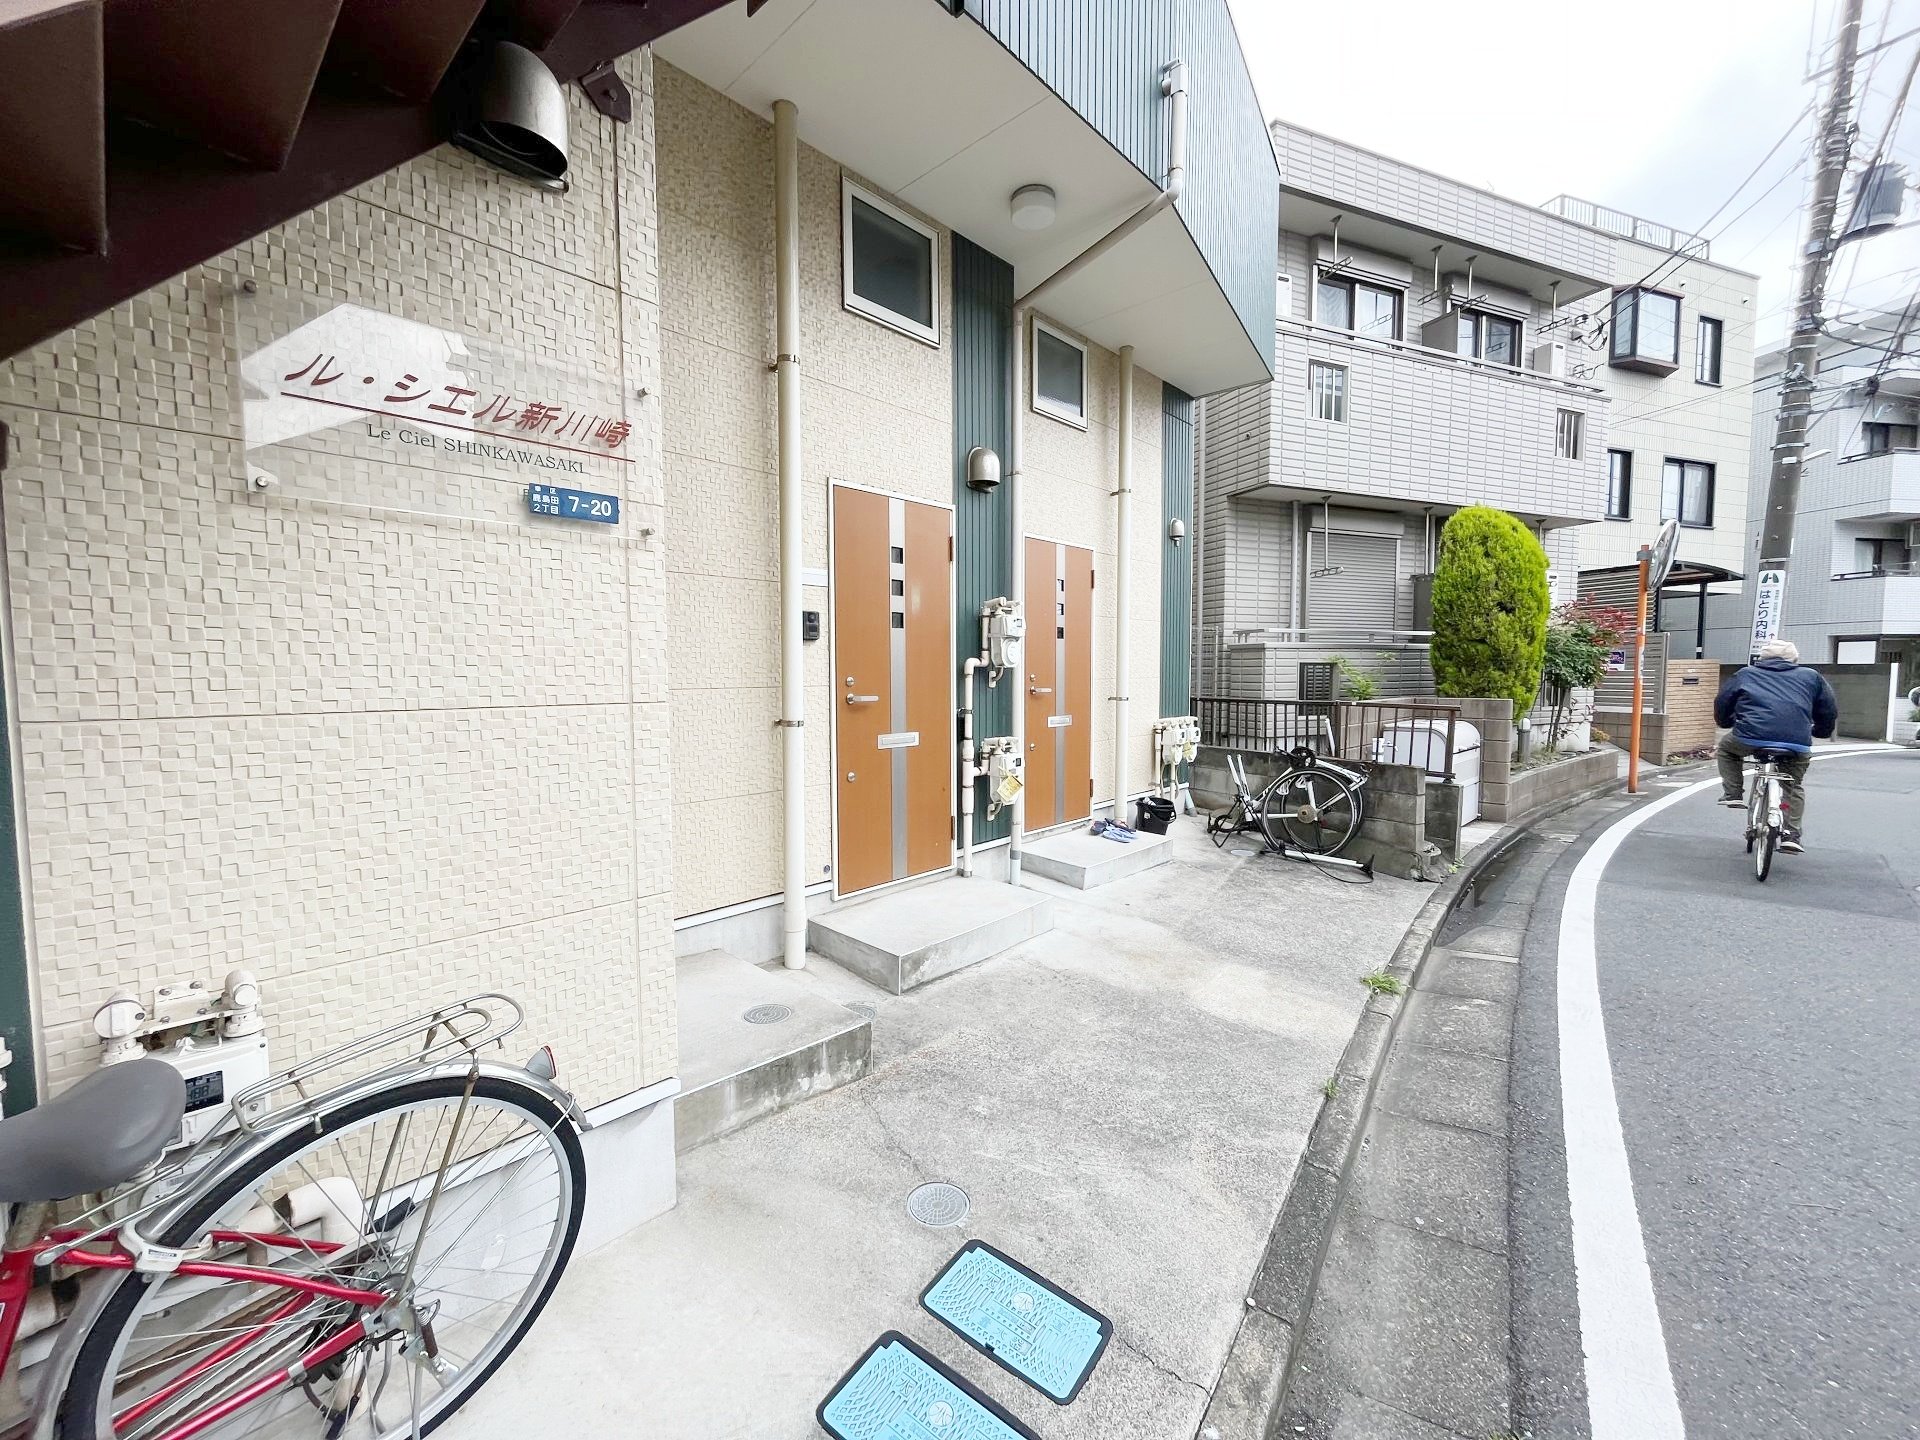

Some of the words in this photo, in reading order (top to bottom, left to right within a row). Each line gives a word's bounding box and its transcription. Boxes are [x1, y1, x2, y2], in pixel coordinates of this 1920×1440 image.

[284, 353, 632, 449] ル・シエル新川崎
[367, 424, 391, 440] Le
[399, 429, 436, 449] Ciel
[444, 438, 585, 474] SHINKAWASAKI
[568, 495, 612, 517] 7-20
